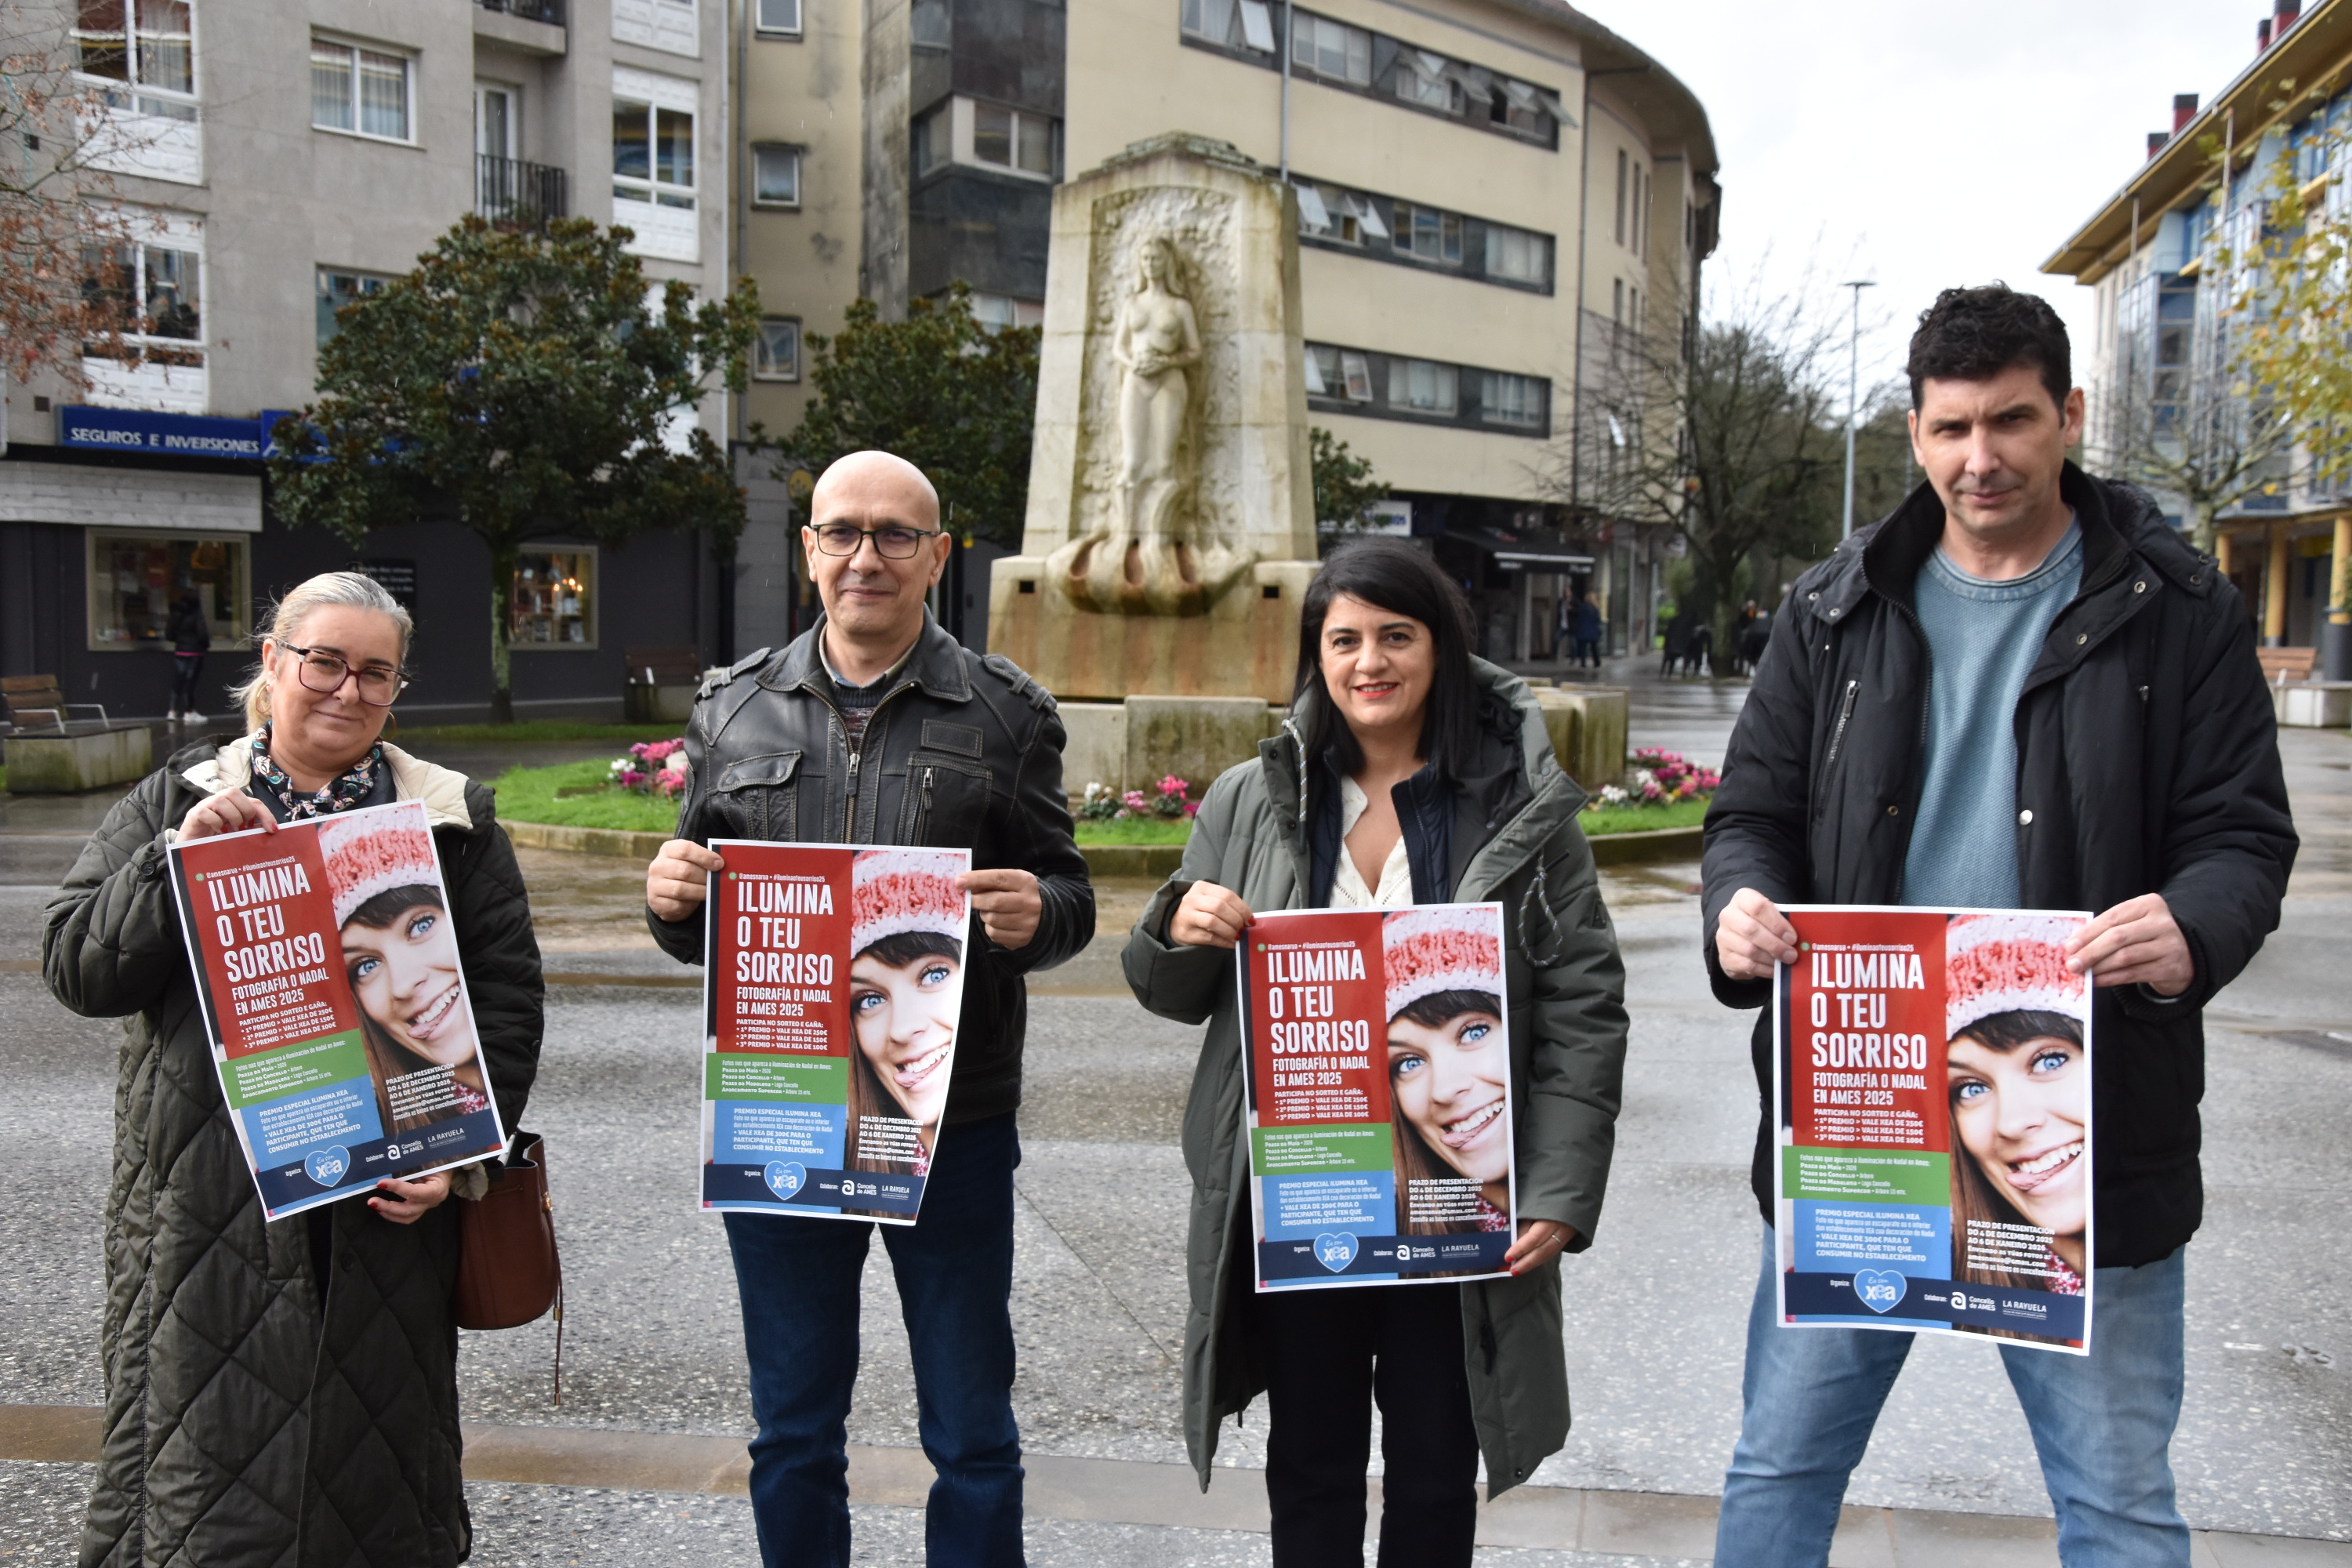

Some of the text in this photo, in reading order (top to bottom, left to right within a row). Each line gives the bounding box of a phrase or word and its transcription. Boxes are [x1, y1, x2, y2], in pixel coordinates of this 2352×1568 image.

[71, 427, 142, 445] SEGUROS
[149, 434, 158, 445] E
[165, 435, 260, 452] INVERSIONES
[208, 863, 311, 912] ILUMINA
[738, 881, 833, 915] ILUMINA
[216, 904, 285, 947] O TEU
[737, 916, 800, 949] O TEU
[223, 932, 325, 982] SORRISO
[736, 951, 833, 985] SORRISO
[1268, 949, 1366, 983] ILUMINA
[231, 967, 329, 1000] FOTOGRAFÍA O NADAL
[1812, 953, 1925, 989] ILUMINA
[235, 988, 304, 1016] EN AMES 2025
[737, 986, 832, 1003] FOTOGRAFÍA O NADAL
[1269, 985, 1334, 1018] O TEU
[239, 1014, 270, 1026] PARTICIPA
[280, 1007, 303, 1017] SORTEO
[308, 1001, 327, 1010] GAÑA:
[252, 1021, 276, 1031] PREMIO
[281, 1015, 296, 1024] VALE
[318, 1007, 332, 1015] 250€
[737, 1001, 804, 1016] EN AMES 2025
[1811, 993, 1886, 1029] O TEU
[1271, 1019, 1369, 1054] SORRISO
[1272, 1055, 1370, 1072] FOTOGRAFÍA O NADAL
[1812, 1032, 1926, 1069] SORRISO
[1273, 1072, 1341, 1087] EN AMES 2025
[1813, 1072, 1927, 1089] FOTOGRAFÍA O NADAL
[259, 1106, 283, 1116] PREMIO
[283, 1099, 311, 1111] ESPECIAL
[311, 1093, 336, 1103] ILUMINA
[1813, 1089, 1893, 1105] EN AMES 2025
[1896, 1109, 1918, 1118] GAÑA:
[267, 1130, 310, 1146] PARTICIPANTE,
[310, 1126, 323, 1135] QUE
[335, 1120, 348, 1128] QUE
[268, 1140, 299, 1153] CONSUMIR
[310, 1123, 361, 1142] ESTABLECEMENTO
[436, 1128, 464, 1140] RAYUELA
[315, 1160, 343, 1179] xea
[2013, 1301, 2046, 1312] RAYUELA
